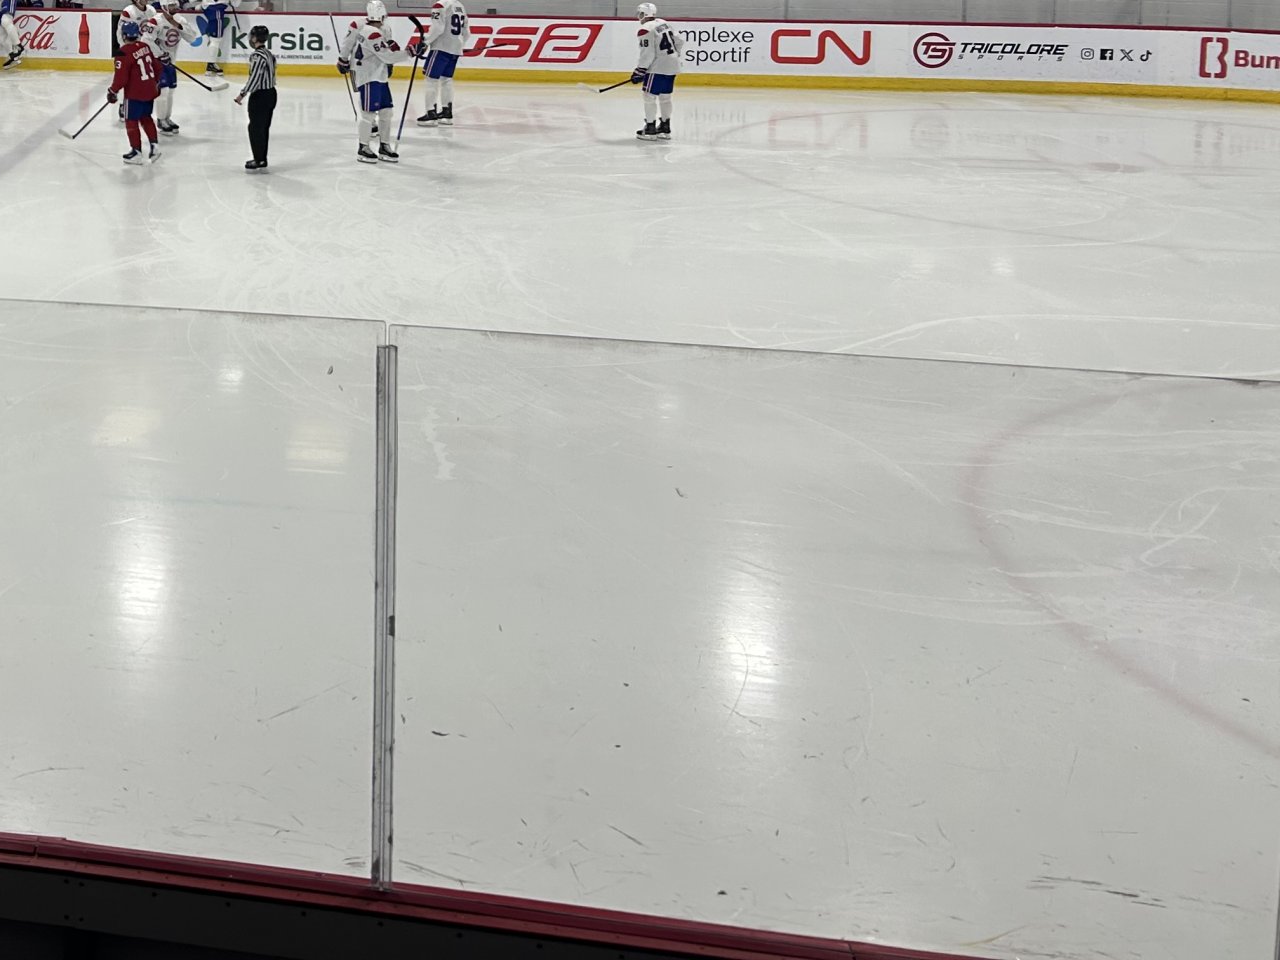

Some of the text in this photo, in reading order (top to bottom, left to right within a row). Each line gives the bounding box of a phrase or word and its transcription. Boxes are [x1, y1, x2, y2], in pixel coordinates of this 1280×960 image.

[232, 26, 324, 51] krsia
[770, 29, 872, 66] CN
[960, 43, 1069, 55] TRICOLORE
[685, 47, 751, 66] sportif
[137, 58, 155, 81] 13
